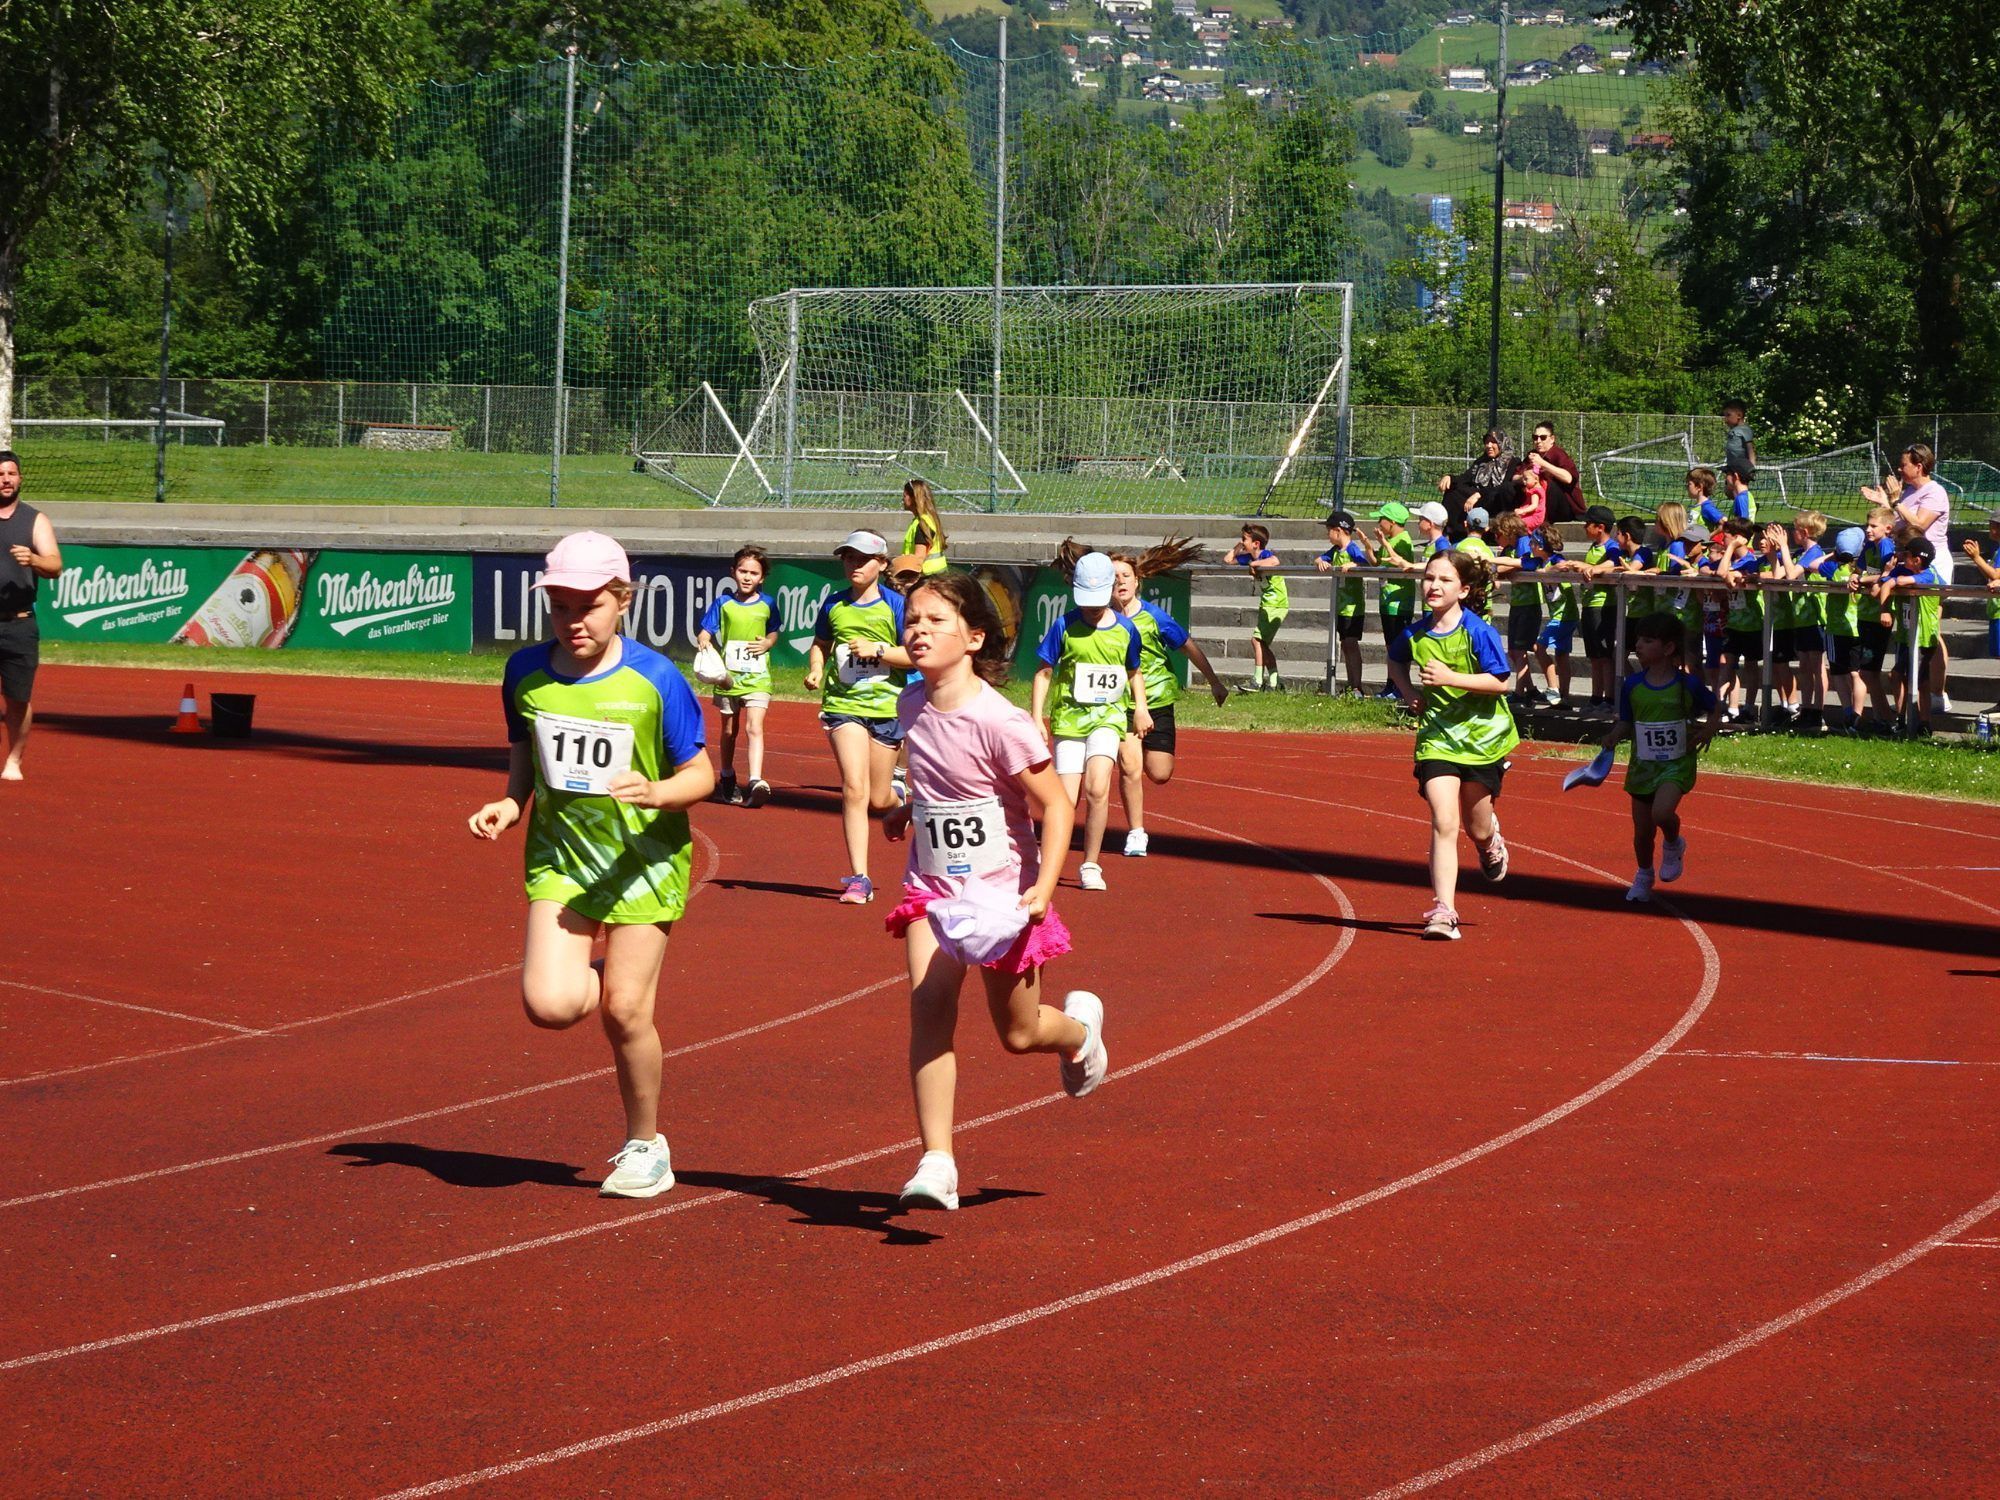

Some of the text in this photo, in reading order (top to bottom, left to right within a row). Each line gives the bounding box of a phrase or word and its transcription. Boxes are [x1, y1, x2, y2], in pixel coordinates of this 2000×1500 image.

[51, 558, 189, 609] Mohrenbräu
[318, 563, 456, 617] Mohrenbräu
[102, 605, 182, 631] das Vorarlberger Bier
[368, 612, 449, 639] das Vorarlberger Bier
[1087, 673, 1118, 689] 143
[552, 731, 612, 768] 110
[1644, 729, 1678, 747] 153
[925, 816, 987, 849] 163
[946, 851, 967, 860] Sara
